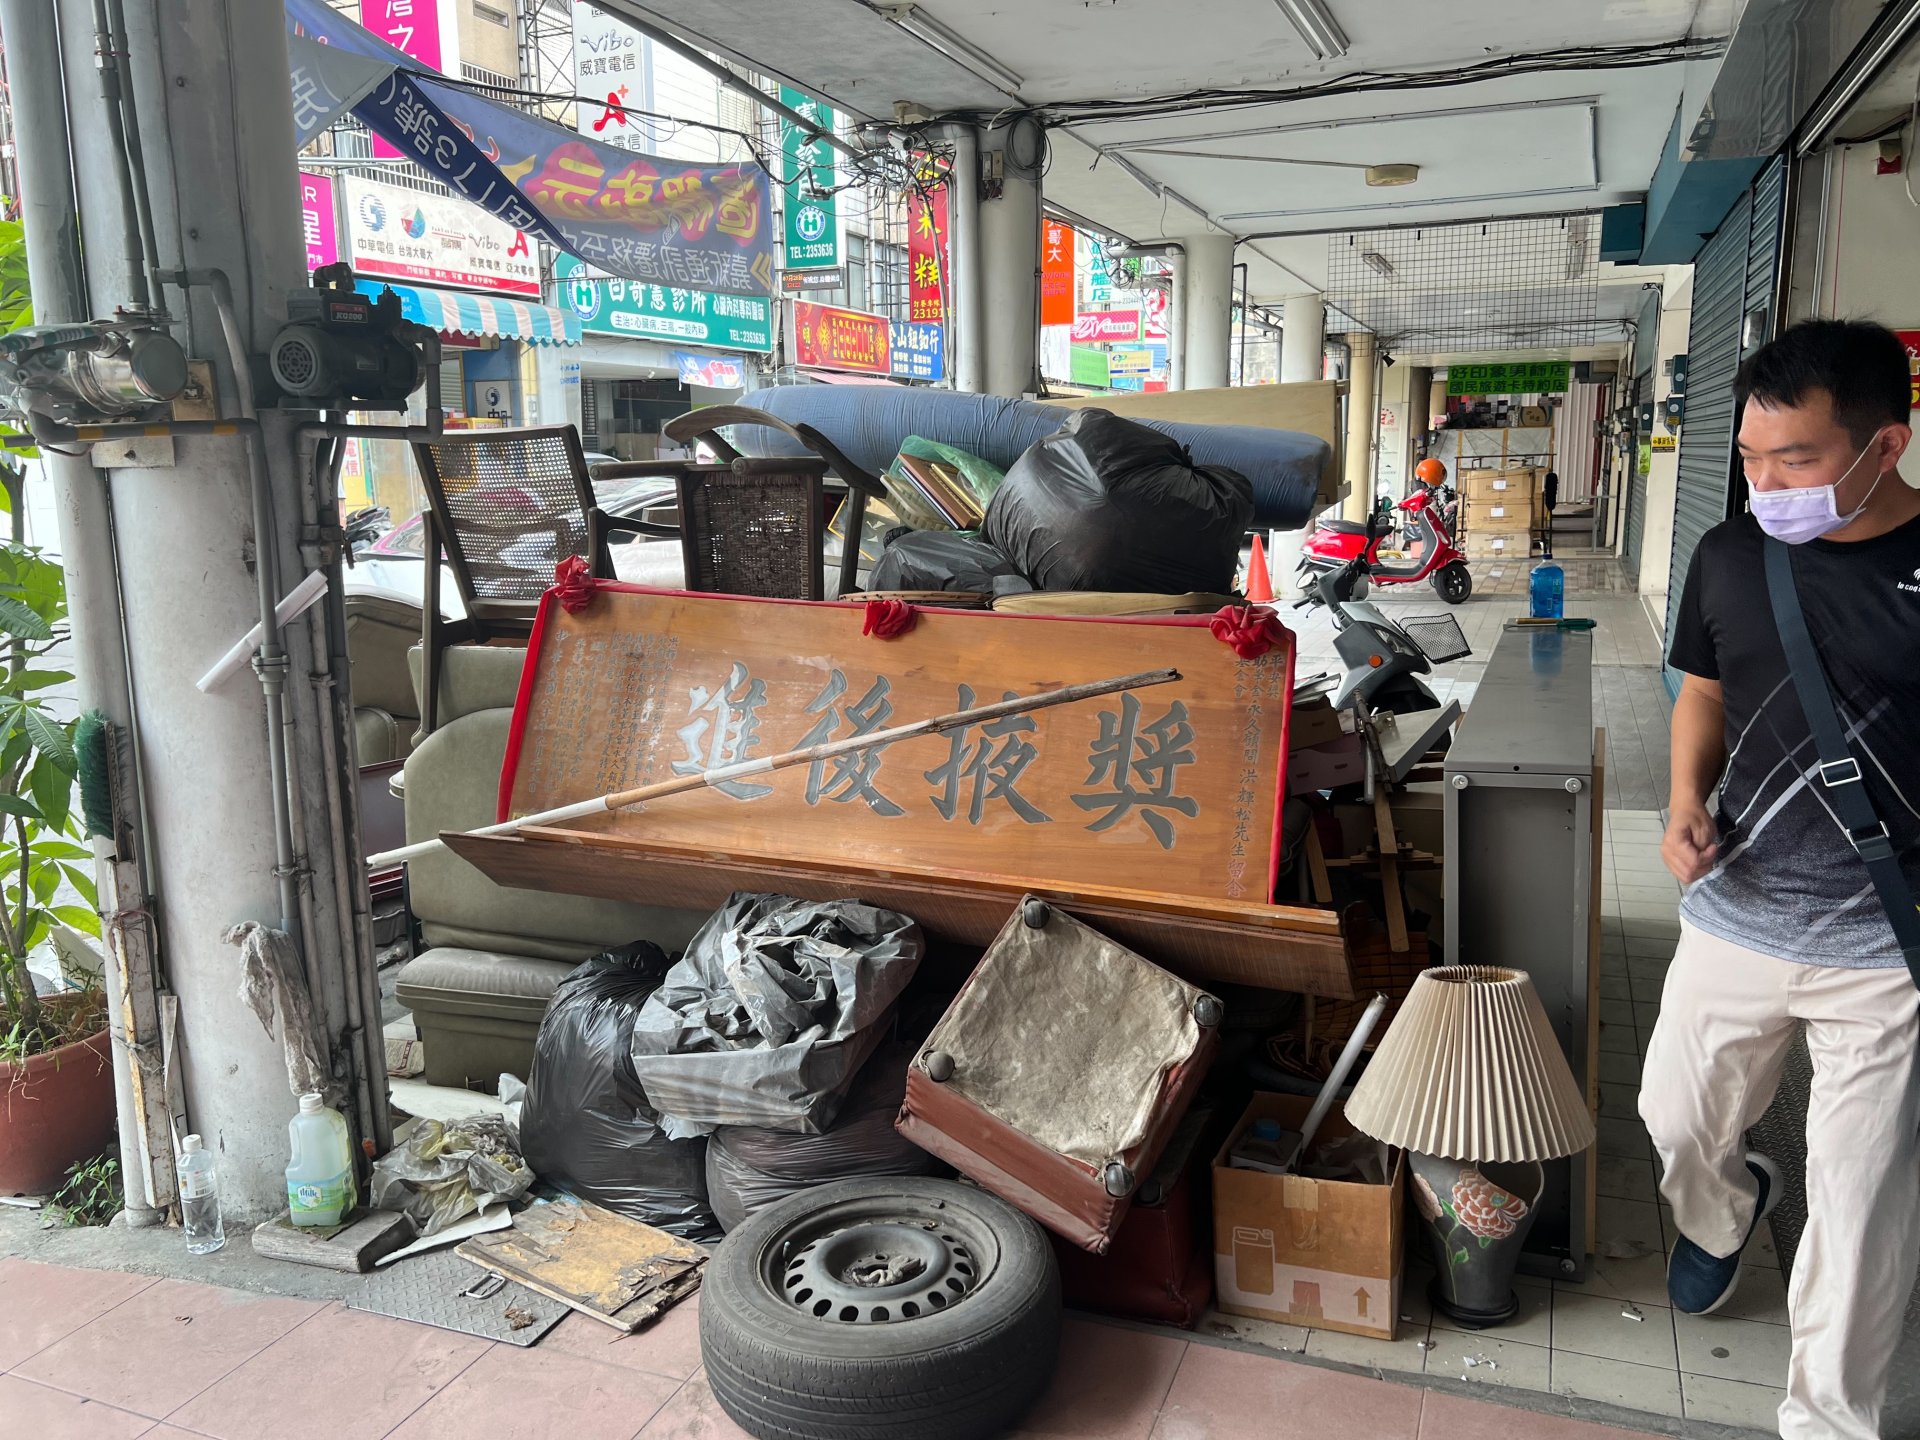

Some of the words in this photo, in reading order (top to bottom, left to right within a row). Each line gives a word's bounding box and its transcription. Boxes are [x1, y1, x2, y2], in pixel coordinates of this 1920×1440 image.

[580, 29, 634, 53] Vibo
[580, 53, 636, 77] 威寶電信
[357, 238, 395, 255] 中華電信
[468, 231, 501, 251] Vibo
[398, 244, 434, 262] 台灣大哥大
[790, 243, 834, 259] TEL:2353636
[506, 262, 535, 276] 亞太電信
[1450, 363, 1567, 379] 好印象男飾店
[1449, 379, 1566, 394] 國民旅遊卡特約店
[671, 661, 1200, 851] 獎掖後進
[299, 1189, 319, 1199] Milk
